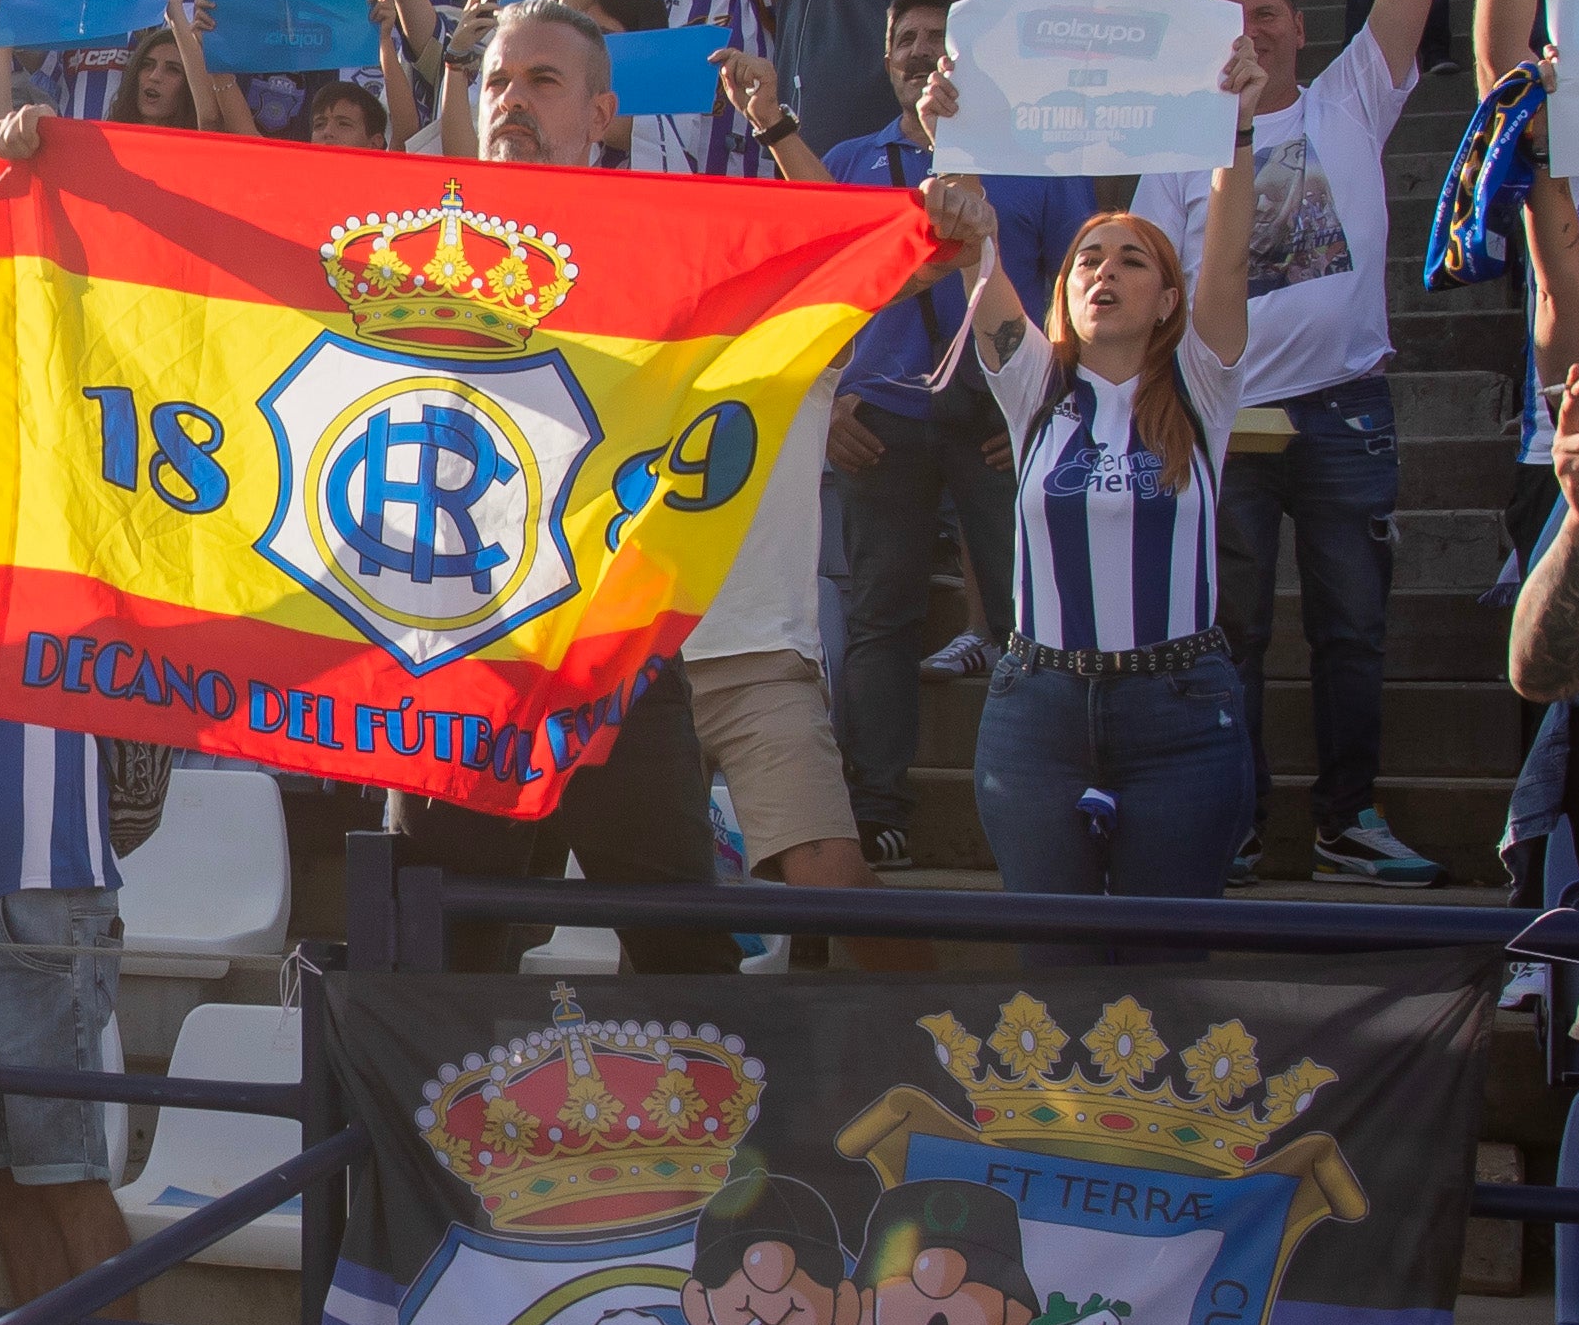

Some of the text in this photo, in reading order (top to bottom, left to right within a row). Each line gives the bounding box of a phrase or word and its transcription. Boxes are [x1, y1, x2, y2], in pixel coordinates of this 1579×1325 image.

[85, 48, 131, 66] CEPS
[82, 387, 231, 515] 18
[1072, 442, 1163, 470] Eterna
[22, 631, 246, 726] DECANO
[248, 680, 344, 749] DEL
[354, 695, 543, 785] FÚTBOL
